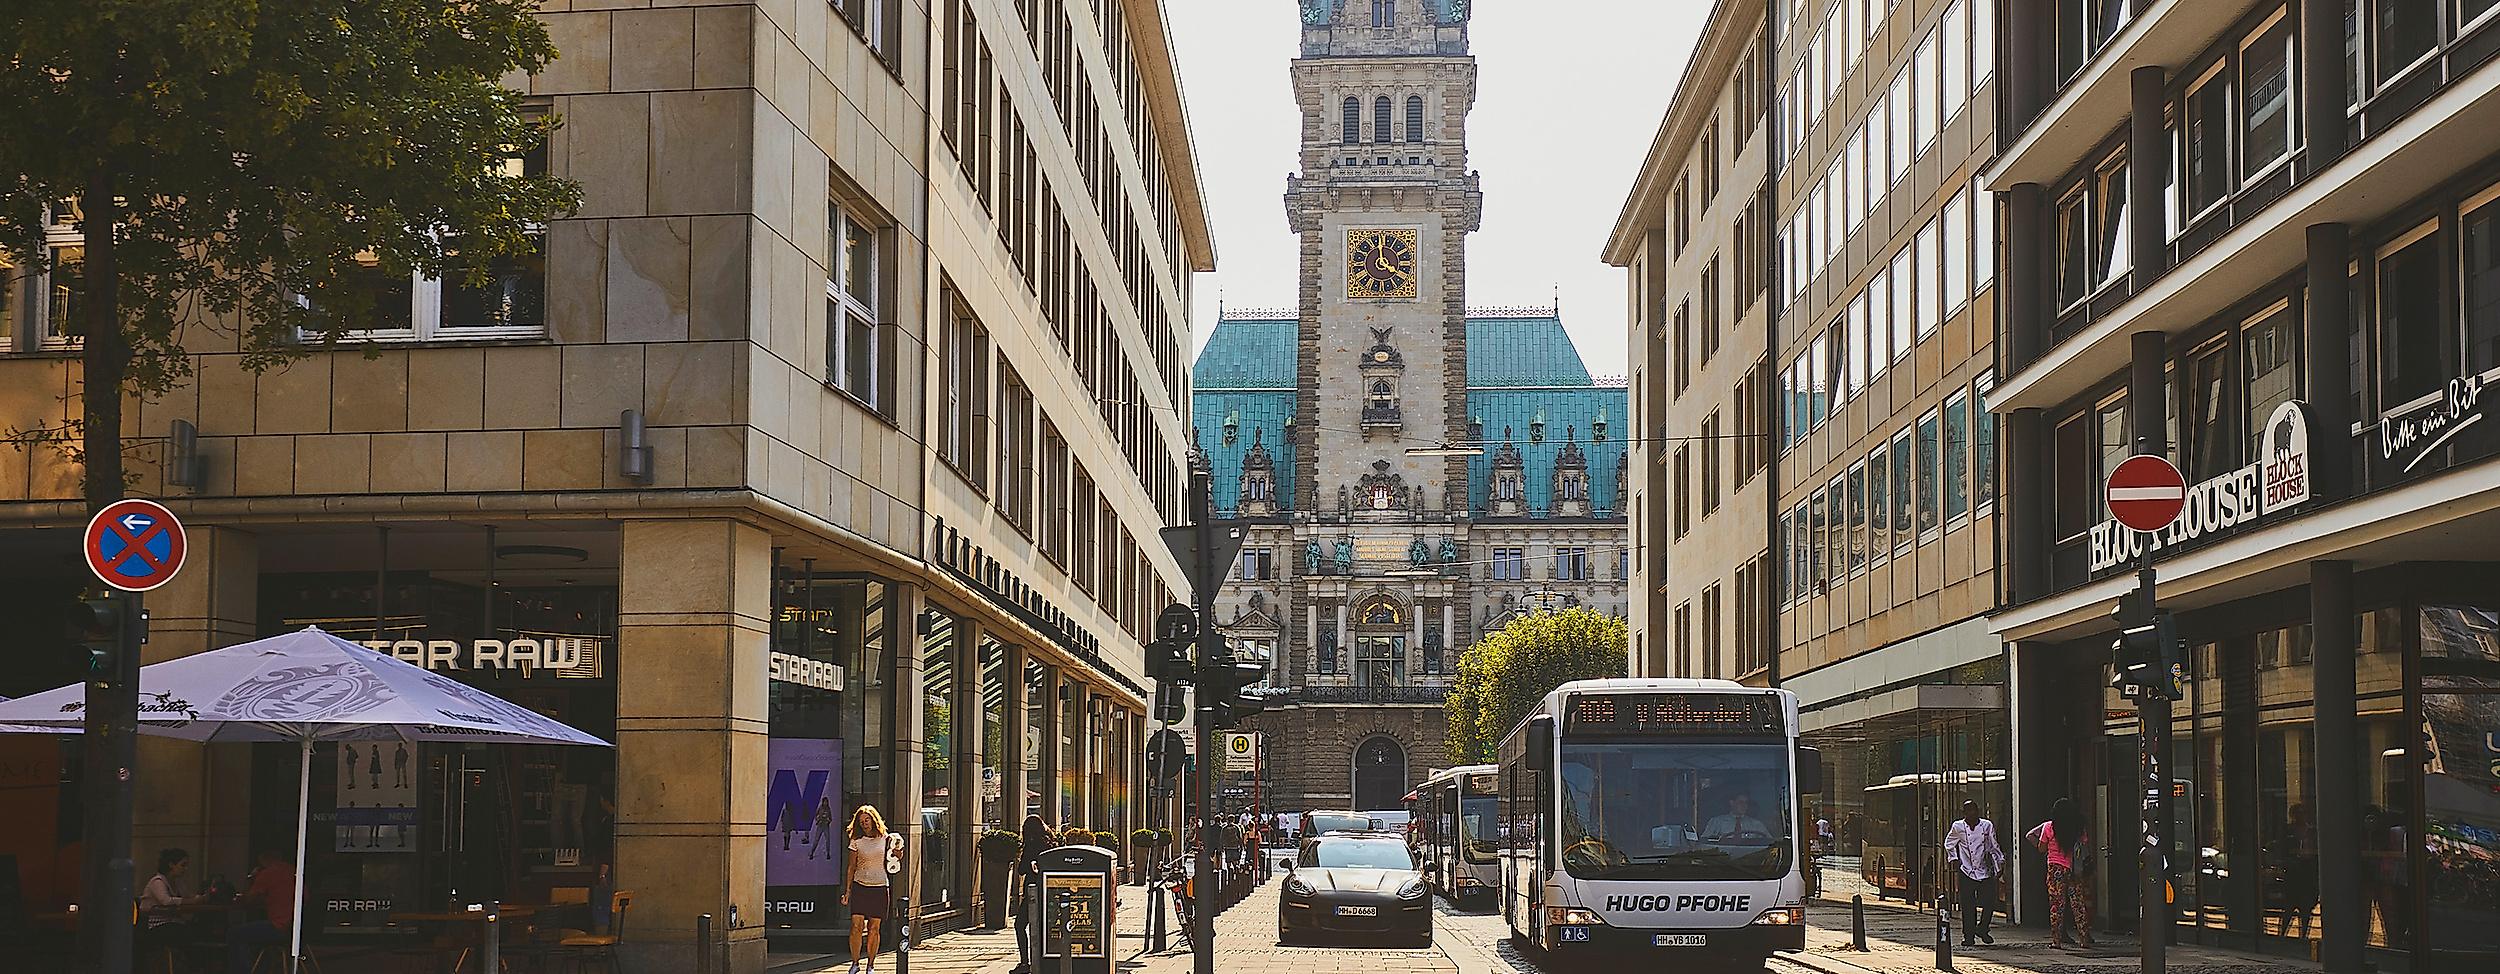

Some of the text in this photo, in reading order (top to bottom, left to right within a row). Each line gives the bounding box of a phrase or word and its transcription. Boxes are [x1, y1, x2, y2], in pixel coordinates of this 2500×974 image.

[2381, 375, 2482, 459] Bitte ein Bit
[2266, 452, 2303, 485] BLOCK
[2266, 475, 2304, 507] HOUSE
[352, 640, 580, 669] TAR RAW
[769, 652, 844, 691] STAR RAW
[776, 902, 814, 912] RAW
[1605, 895, 1751, 912] HUGO PFOHE
[1657, 935, 1705, 945] HH YB 1016
